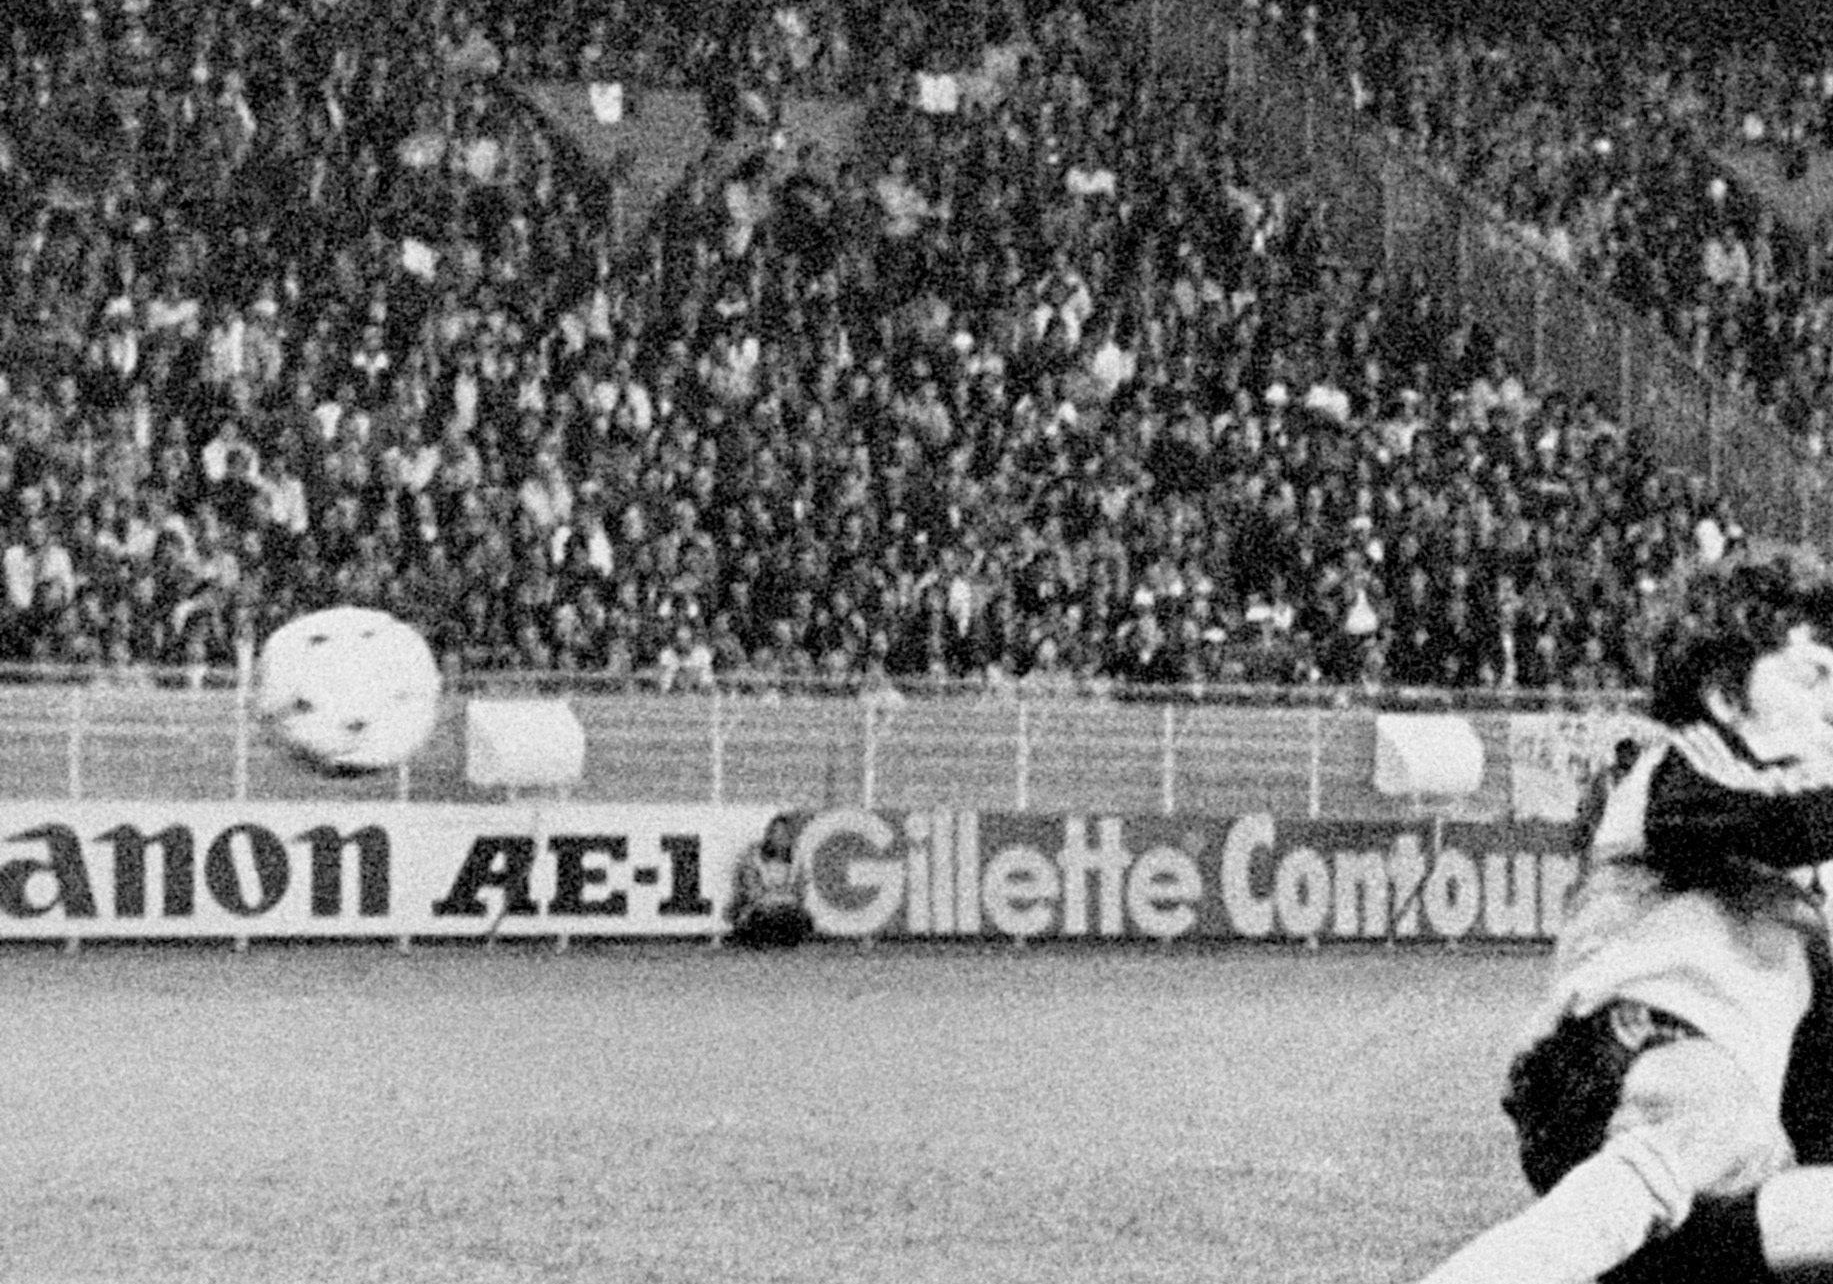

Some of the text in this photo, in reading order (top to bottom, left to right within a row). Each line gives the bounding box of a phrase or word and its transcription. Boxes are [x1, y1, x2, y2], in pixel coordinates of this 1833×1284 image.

[0, 822, 713, 918] anon AE-1
[802, 806, 1582, 938] Gillette Contour
